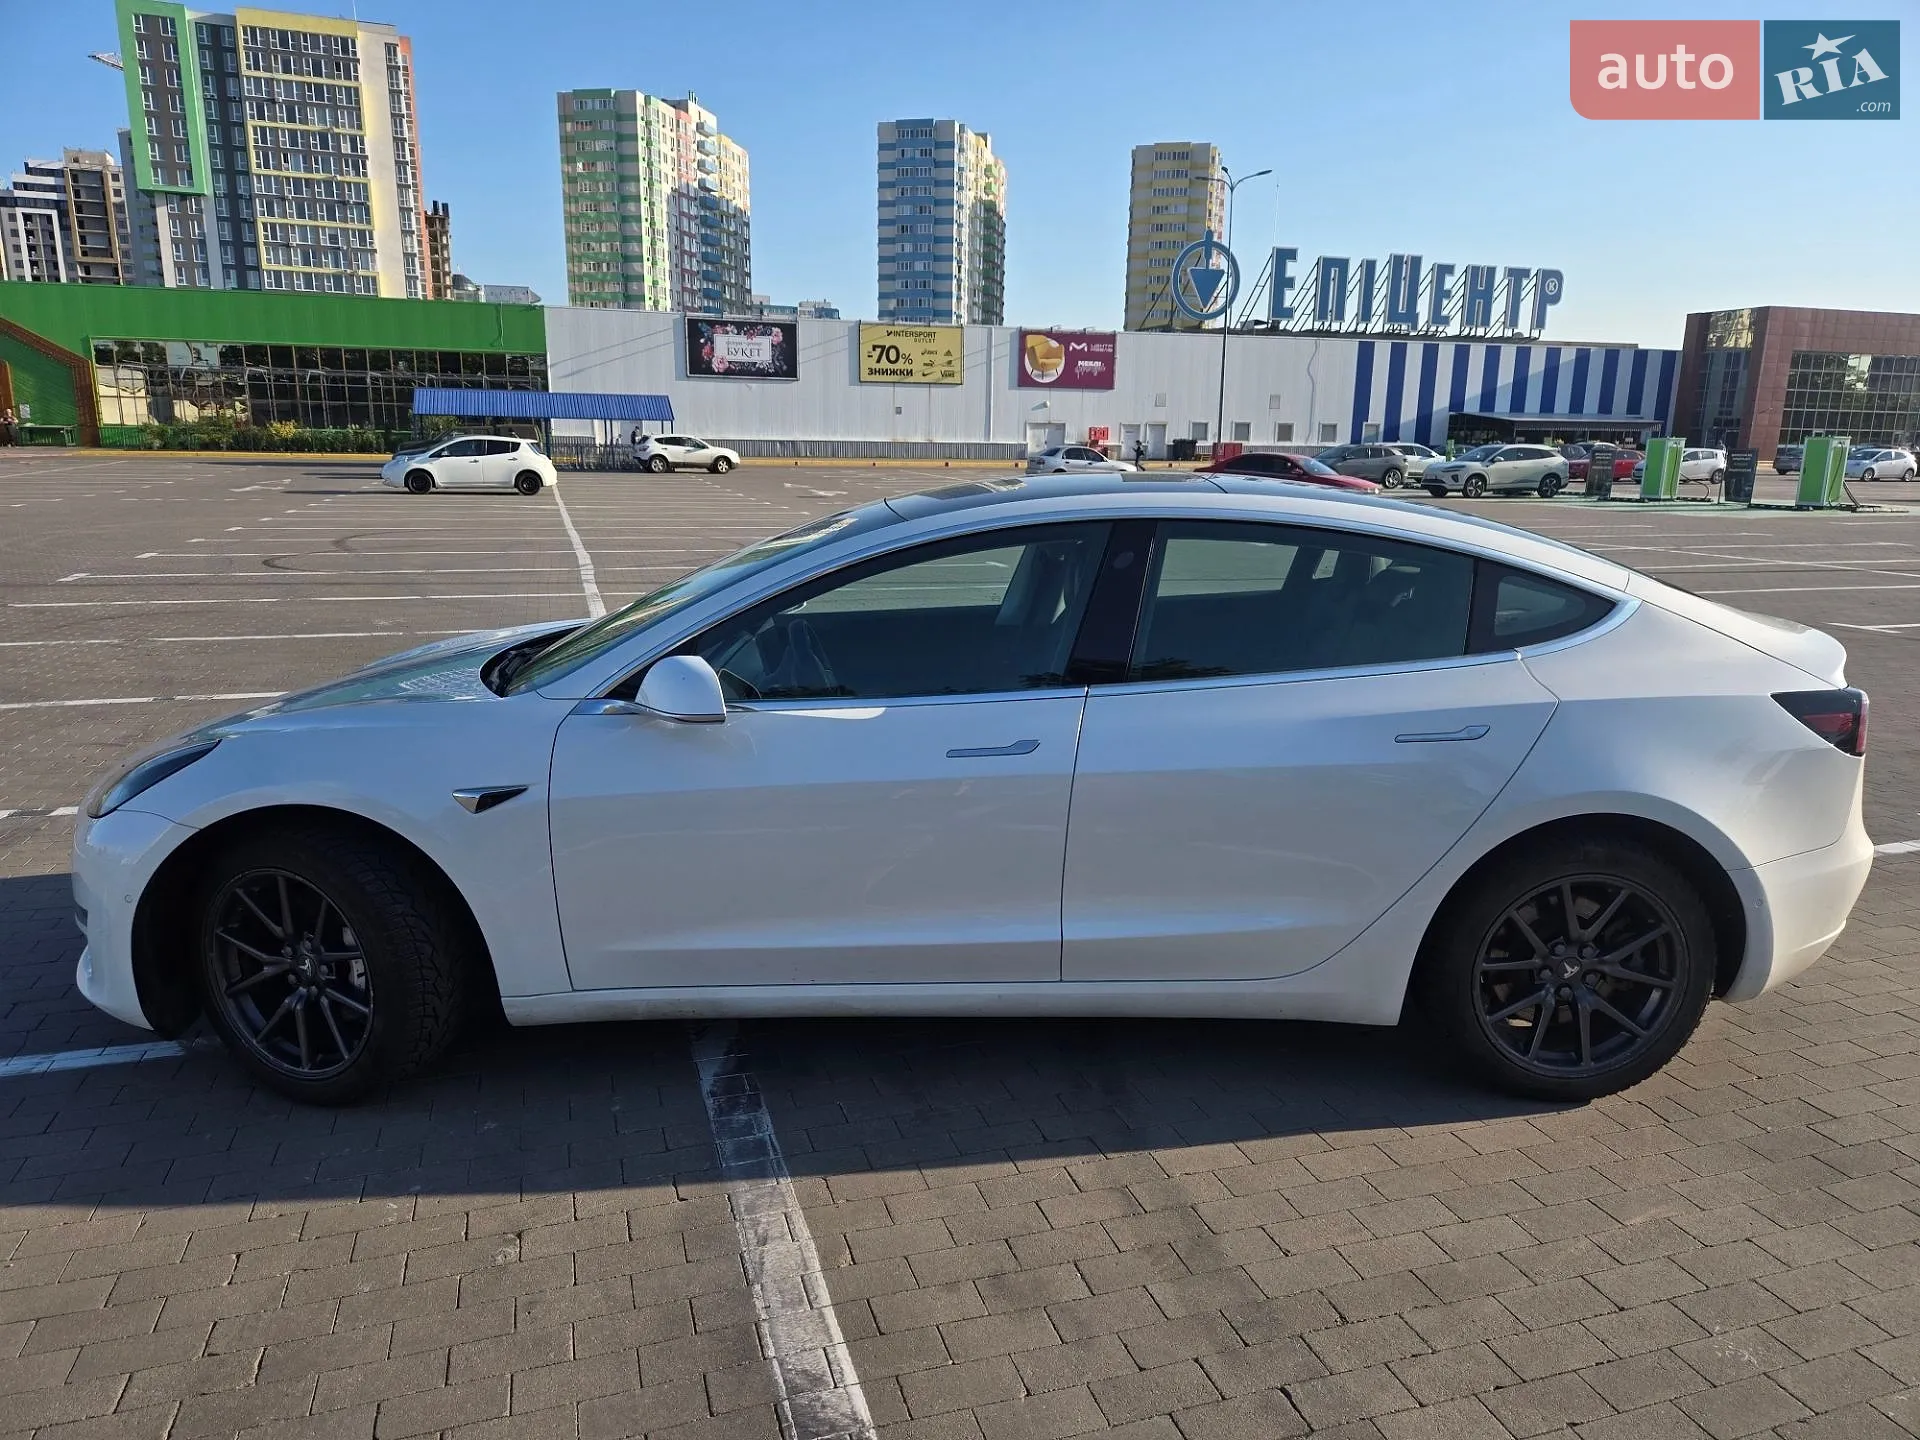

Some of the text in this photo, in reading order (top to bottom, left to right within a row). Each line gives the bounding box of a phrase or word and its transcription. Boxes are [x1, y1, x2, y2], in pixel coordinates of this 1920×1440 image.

[1268, 246, 1565, 330] ЕПІЦЕНТР
[893, 330, 936, 338] INTERSPORT
[868, 367, 913, 377] ЗНИЖКИ
